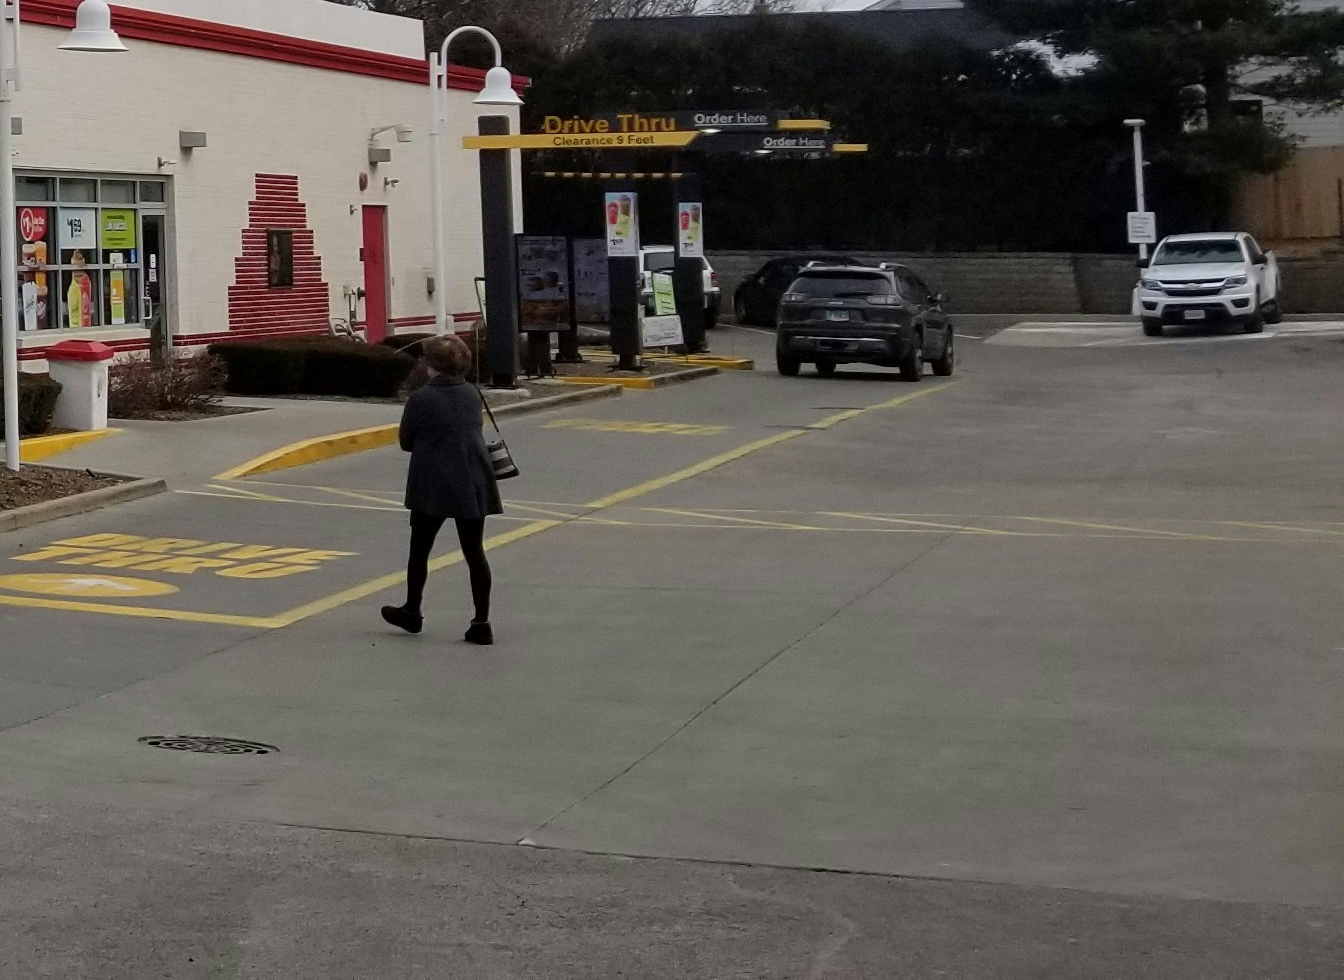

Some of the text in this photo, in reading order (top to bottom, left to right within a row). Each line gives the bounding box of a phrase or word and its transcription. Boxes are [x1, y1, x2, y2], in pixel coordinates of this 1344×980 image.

[543, 113, 677, 133] Drive Thru
[694, 112, 768, 124] Order Here
[553, 135, 613, 146] Clearance
[627, 134, 655, 145] Feet
[763, 136, 826, 146] Order Here
[47, 533, 361, 564] DRIVE
[8, 546, 322, 579] THRU
